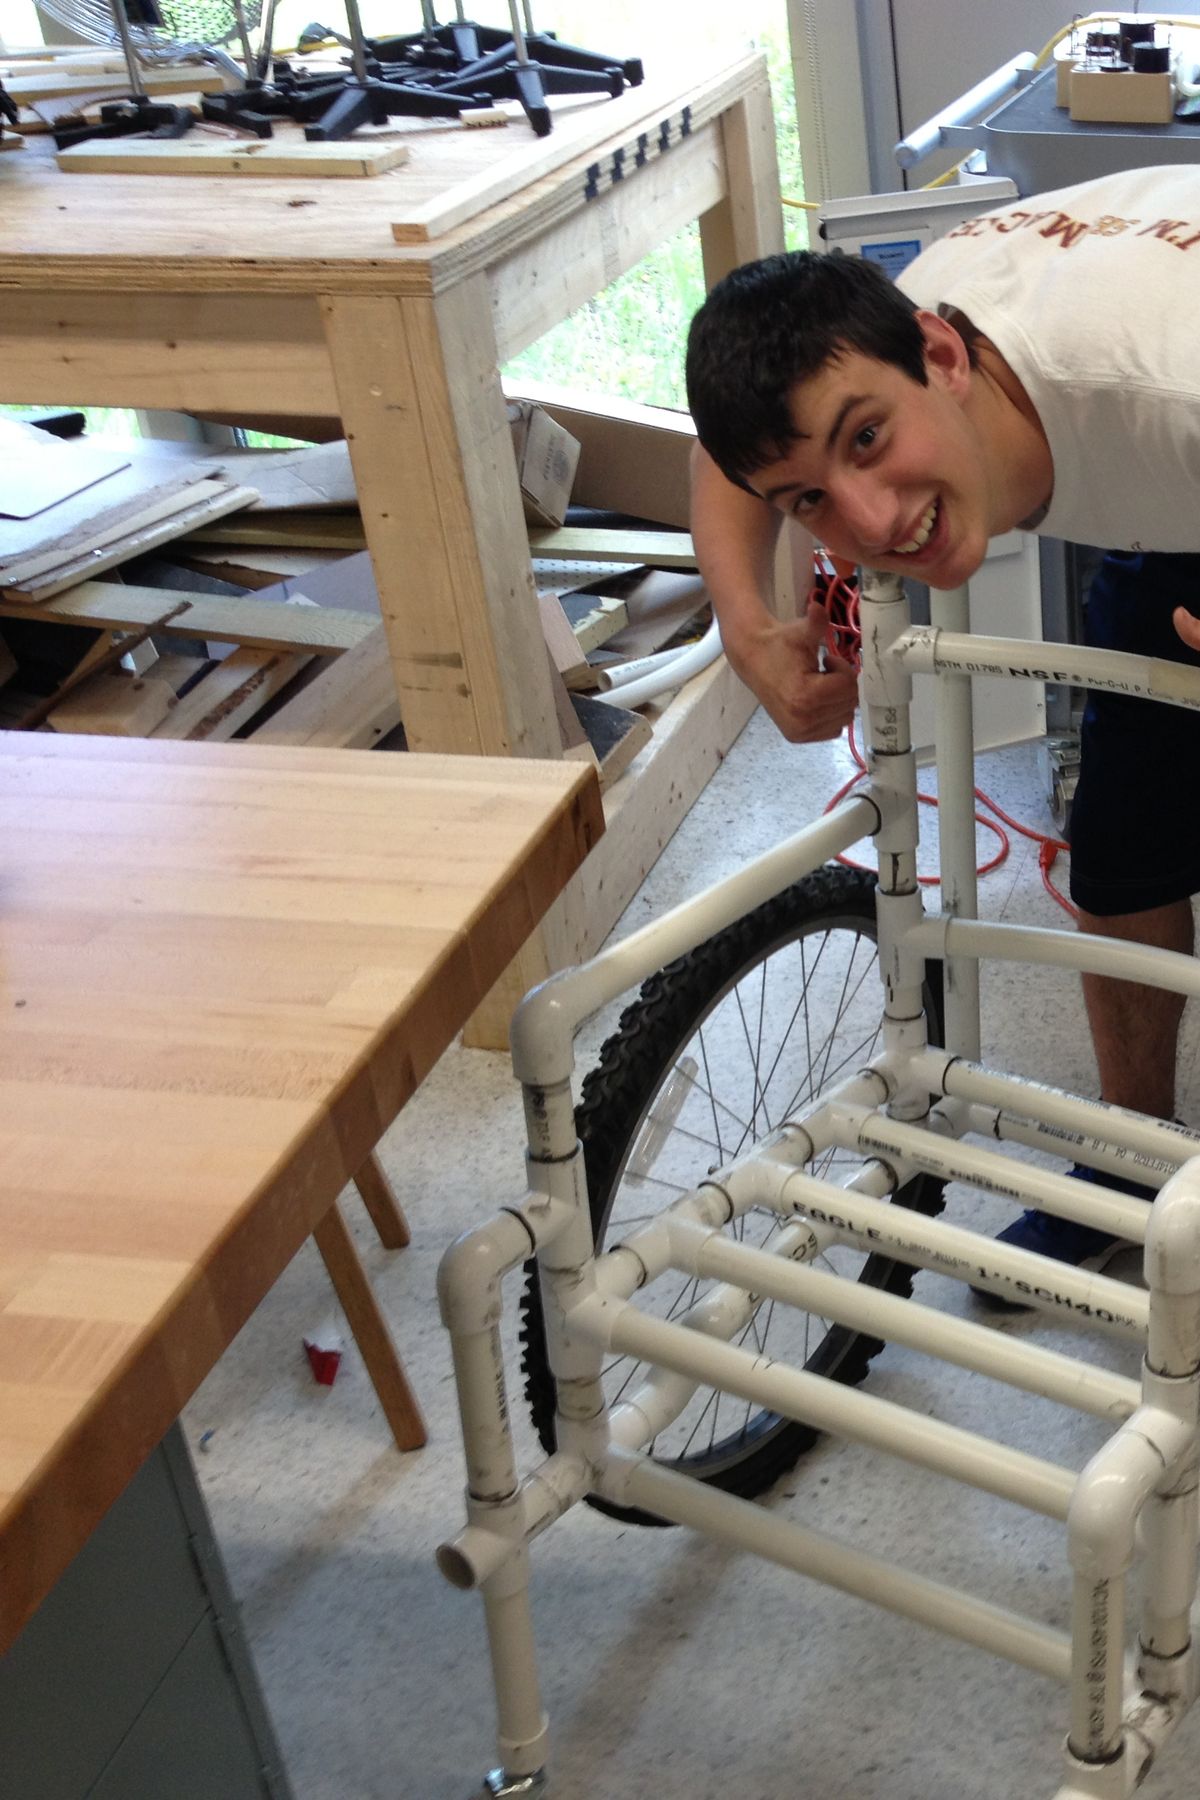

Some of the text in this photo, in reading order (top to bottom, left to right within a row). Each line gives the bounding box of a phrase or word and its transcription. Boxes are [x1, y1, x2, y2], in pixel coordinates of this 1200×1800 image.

[1008, 667, 1068, 682] NSF
[792, 1201, 883, 1242] EAGLE
[1014, 1279, 1115, 1323] SCH40
